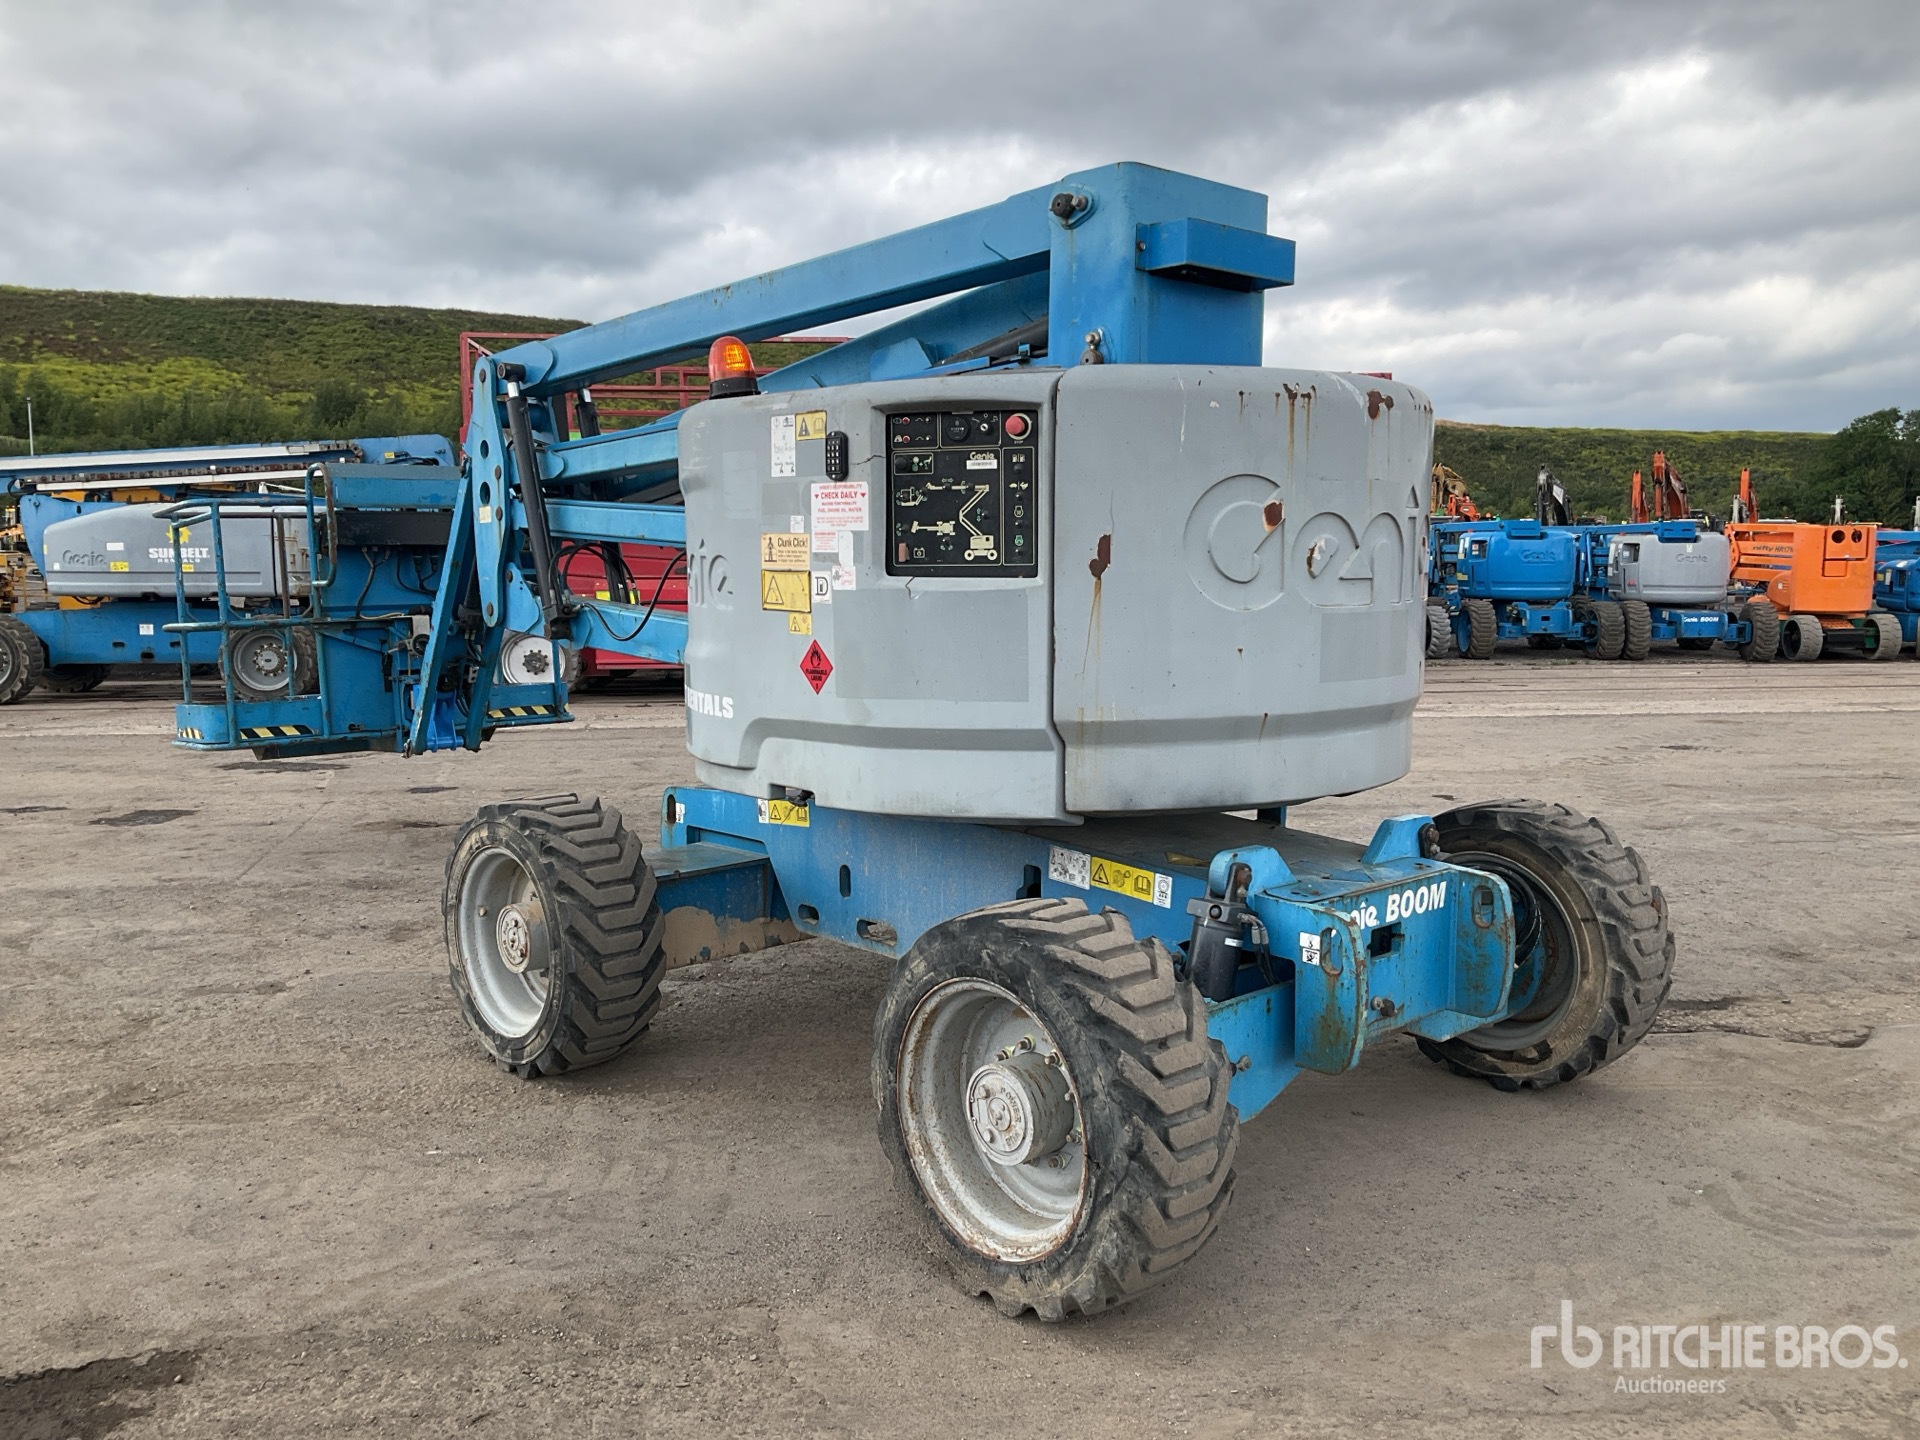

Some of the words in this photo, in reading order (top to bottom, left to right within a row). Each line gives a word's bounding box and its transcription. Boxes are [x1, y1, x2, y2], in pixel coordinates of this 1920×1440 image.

[970, 451, 995, 460] Genie
[840, 491, 858, 499] DAILY
[777, 537, 792, 548] Clunk
[793, 537, 808, 548] Click!
[63, 549, 108, 567] Genie
[1520, 550, 1556, 563] Genie
[1675, 553, 1708, 563] Genie
[1386, 881, 1447, 922] BOOM
